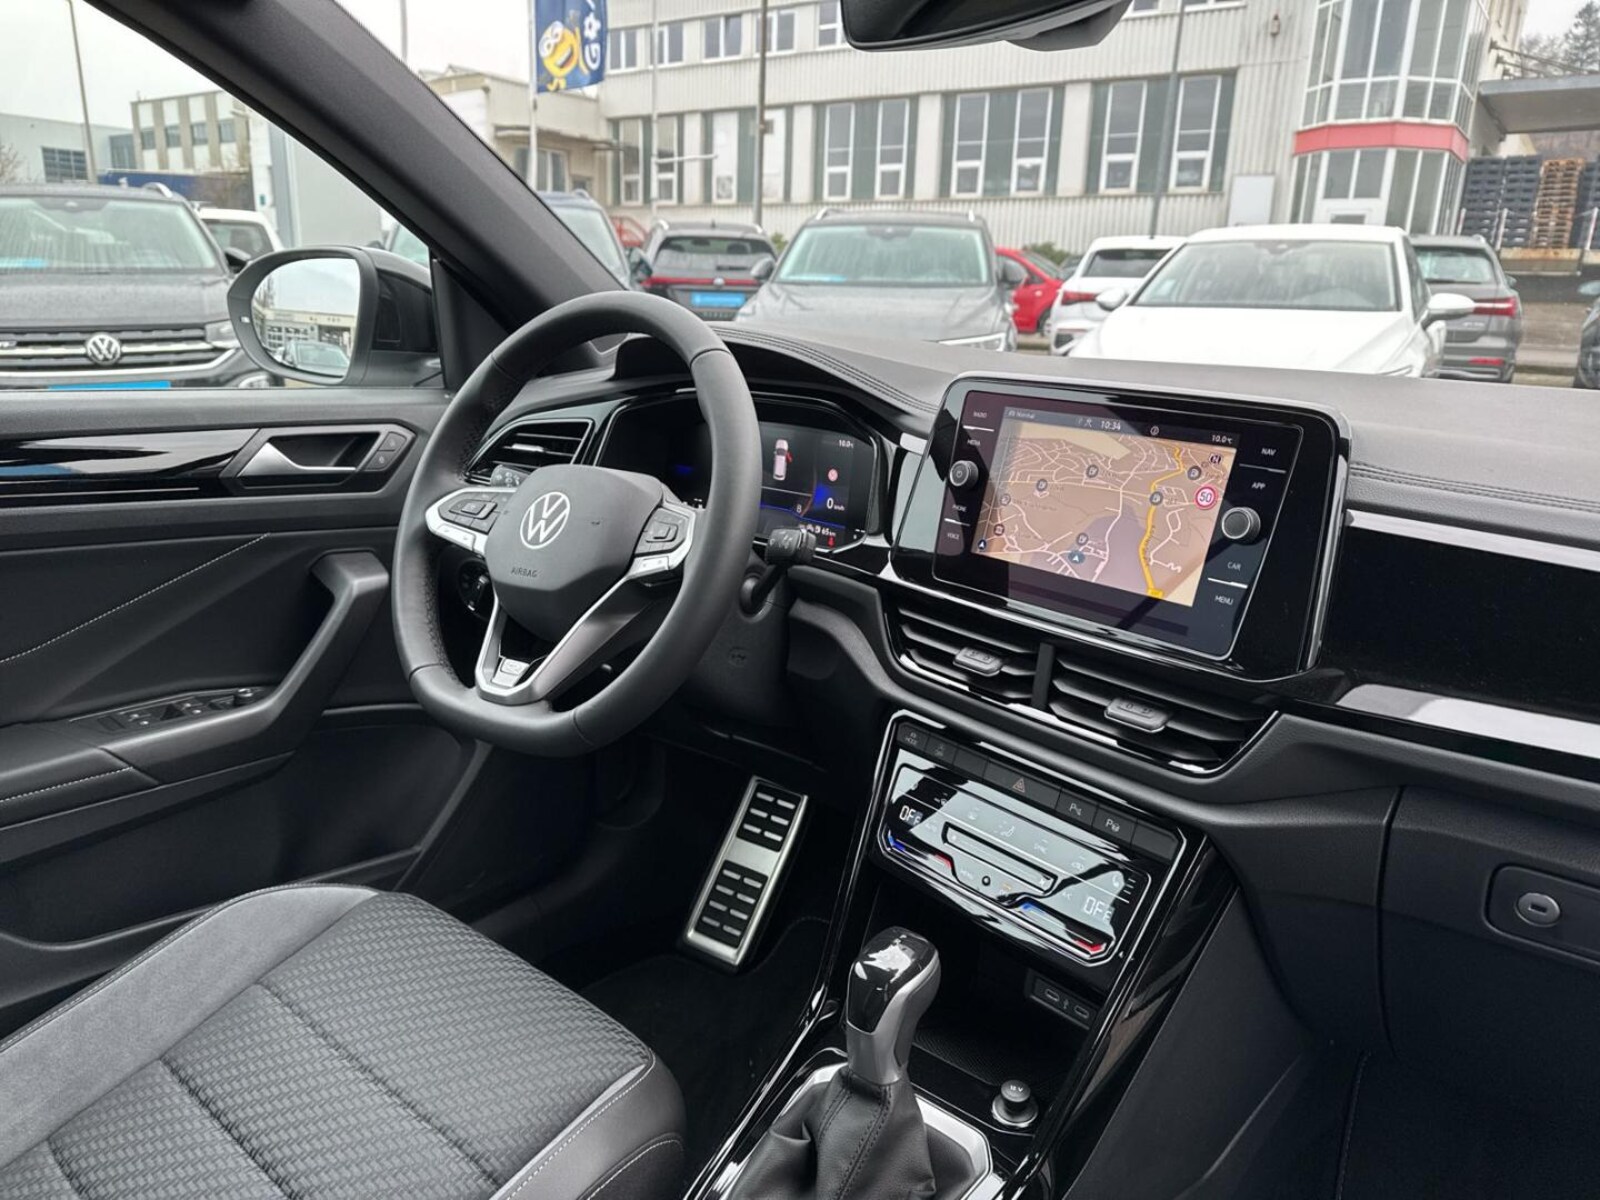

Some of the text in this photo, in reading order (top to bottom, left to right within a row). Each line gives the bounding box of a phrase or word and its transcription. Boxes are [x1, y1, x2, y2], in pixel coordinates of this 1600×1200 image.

[1101, 421, 1121, 431] 10:34
[1261, 448, 1276, 456] NAV
[1251, 482, 1266, 490] APP
[1200, 491, 1212, 503] 50
[1227, 561, 1241, 571] CAR
[511, 567, 538, 578] AIRBAG
[1215, 595, 1234, 605] MENU
